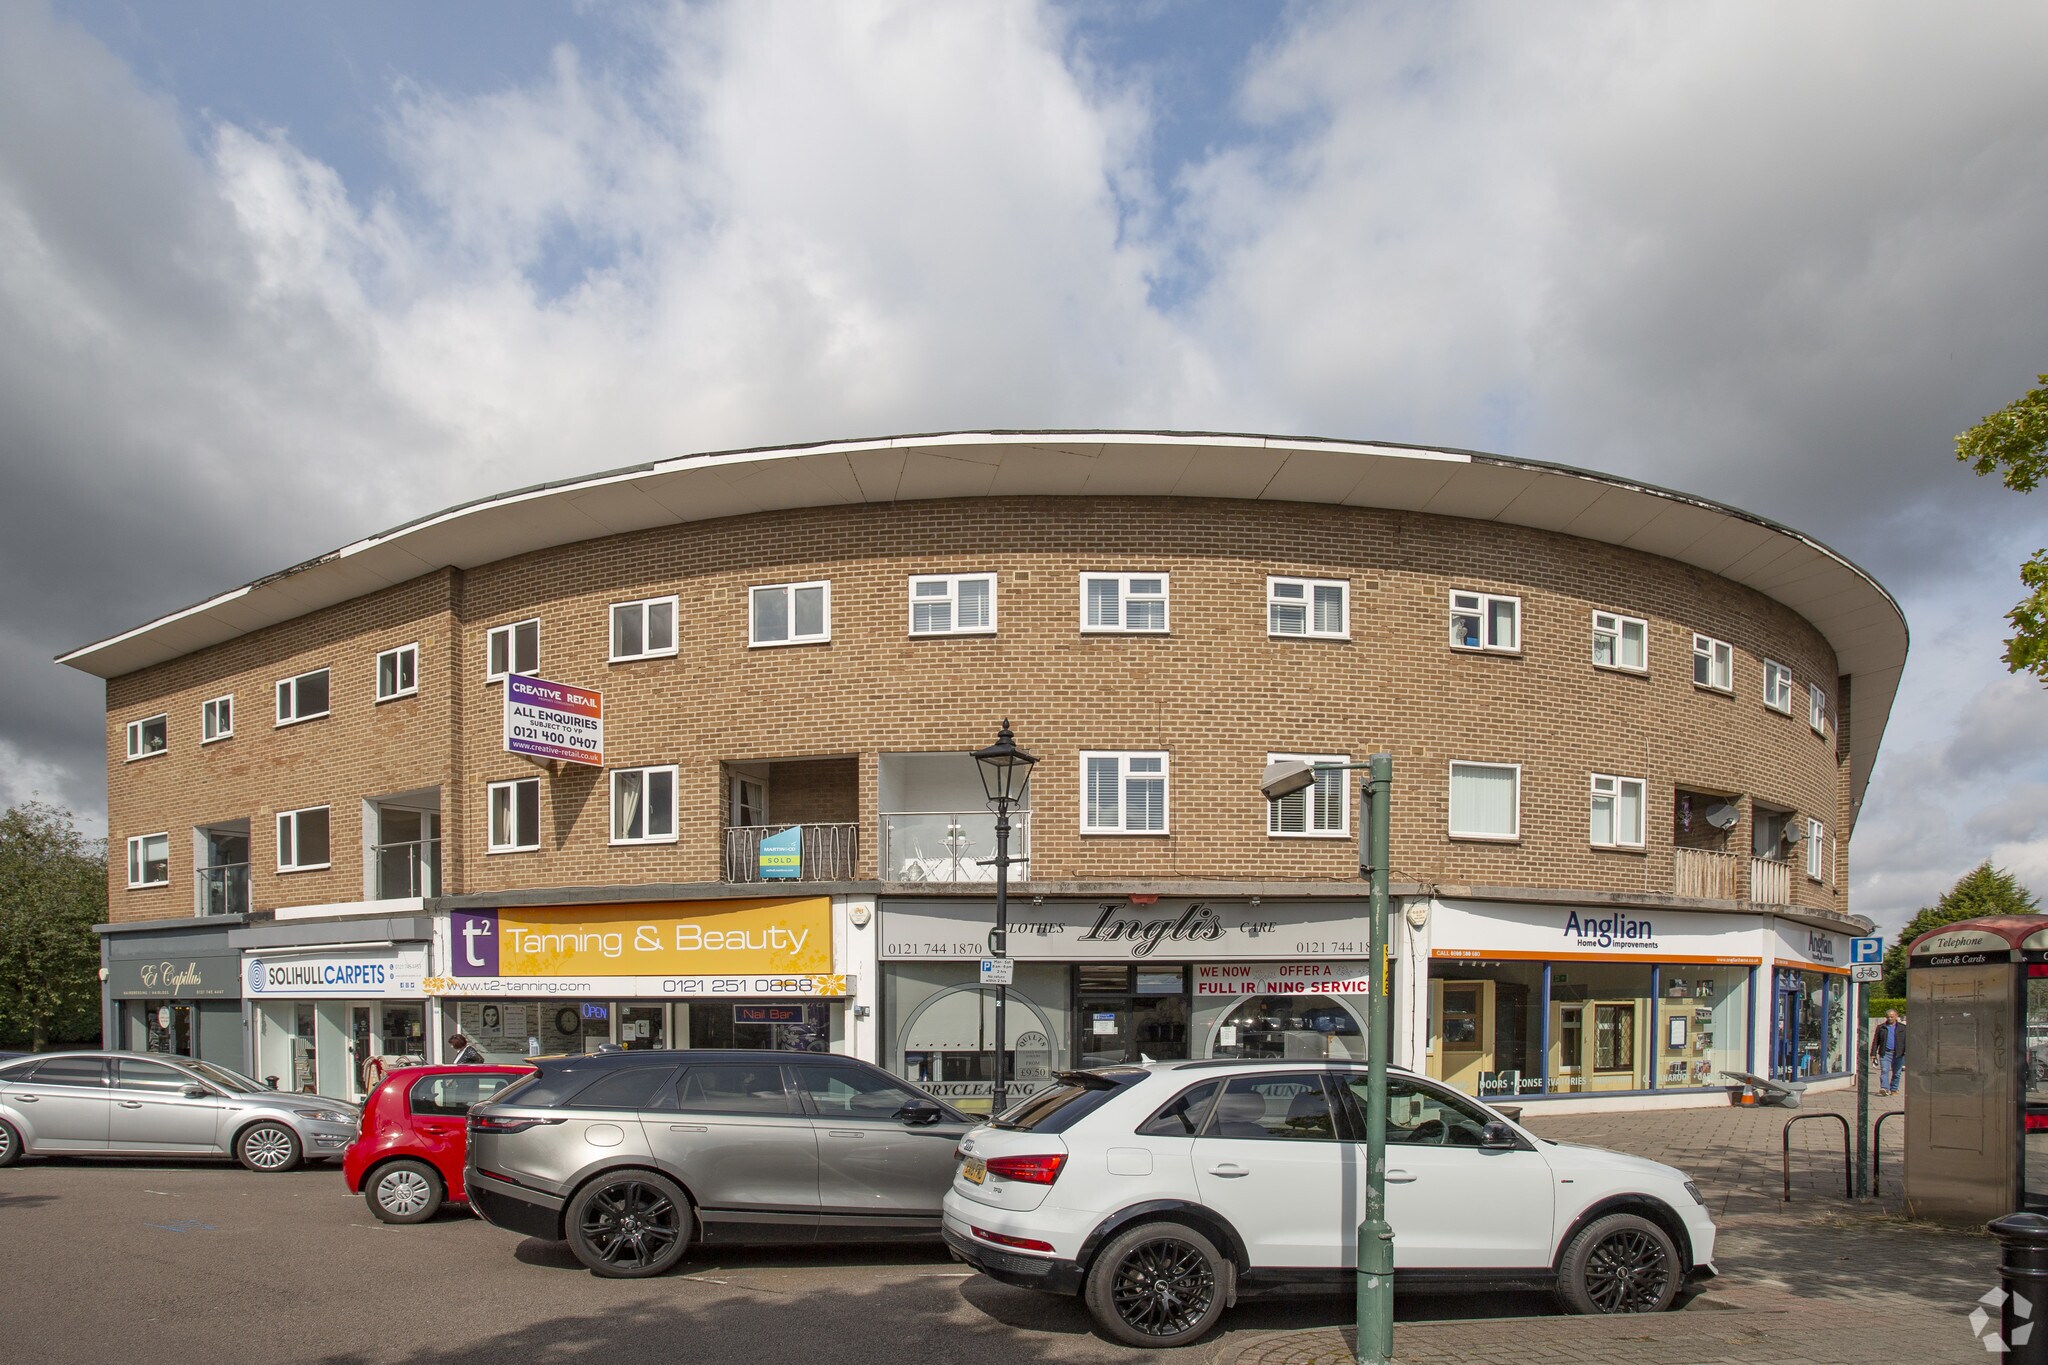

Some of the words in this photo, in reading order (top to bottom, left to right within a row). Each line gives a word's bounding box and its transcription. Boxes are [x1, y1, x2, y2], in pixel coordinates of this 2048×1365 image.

[512, 682, 561, 700] CREATIVE
[566, 694, 598, 708] RETAIL
[514, 706, 535, 718] ALL
[538, 710, 598, 730] ENQUIRIES
[530, 720, 560, 730] SUBJECT
[514, 726, 537, 739] 0121
[542, 730, 564, 744] 400
[569, 736, 597, 749] 0407
[512, 741, 598, 761] www.creative-retail.co.uk
[1005, 922, 1065, 934] LOTHES
[1078, 902, 1228, 958] Inglis
[1240, 922, 1277, 933] CARE
[1564, 911, 1652, 948] Anglian
[506, 928, 622, 958] Tanning
[634, 925, 664, 951] &
[676, 924, 808, 955] Beauty
[1296, 942, 1325, 953] 0121
[1331, 942, 1353, 953] 744
[1359, 942, 1371, 953] 18
[1808, 930, 1832, 960] Anglian
[1938, 936, 1983, 948] Telephone
[888, 944, 918, 954] 0121
[924, 944, 947, 954] 744
[952, 943, 982, 954] 1870
[1857, 940, 1878, 962] P
[1930, 956, 1952, 965] Coins
[1952, 956, 1960, 964] &
[1962, 955, 1986, 963] Cards
[1200, 967, 1219, 977] WE
[1222, 967, 1251, 977] NOW
[1279, 965, 1320, 976] OFFER
[1322, 966, 1331, 975] A
[160, 962, 201, 995] Capillus
[448, 980, 591, 993] www.t2-tanning.com
[663, 980, 703, 992] 0121
[712, 980, 746, 992] 251
[755, 979, 813, 992] 0888
[1199, 983, 1236, 994] FULL
[1311, 981, 1370, 993] SERVIC
[743, 1009, 766, 1019] Nail
[769, 1009, 793, 1019] Bar
[1020, 1035, 1046, 1047] QUILTS
[1021, 1068, 1046, 1076] £9.50
[1480, 1080, 1507, 1089] DOORS
[1517, 1076, 1586, 1088] CONSERVATORIES
[921, 1084, 1035, 1096] DRYCLEAING
